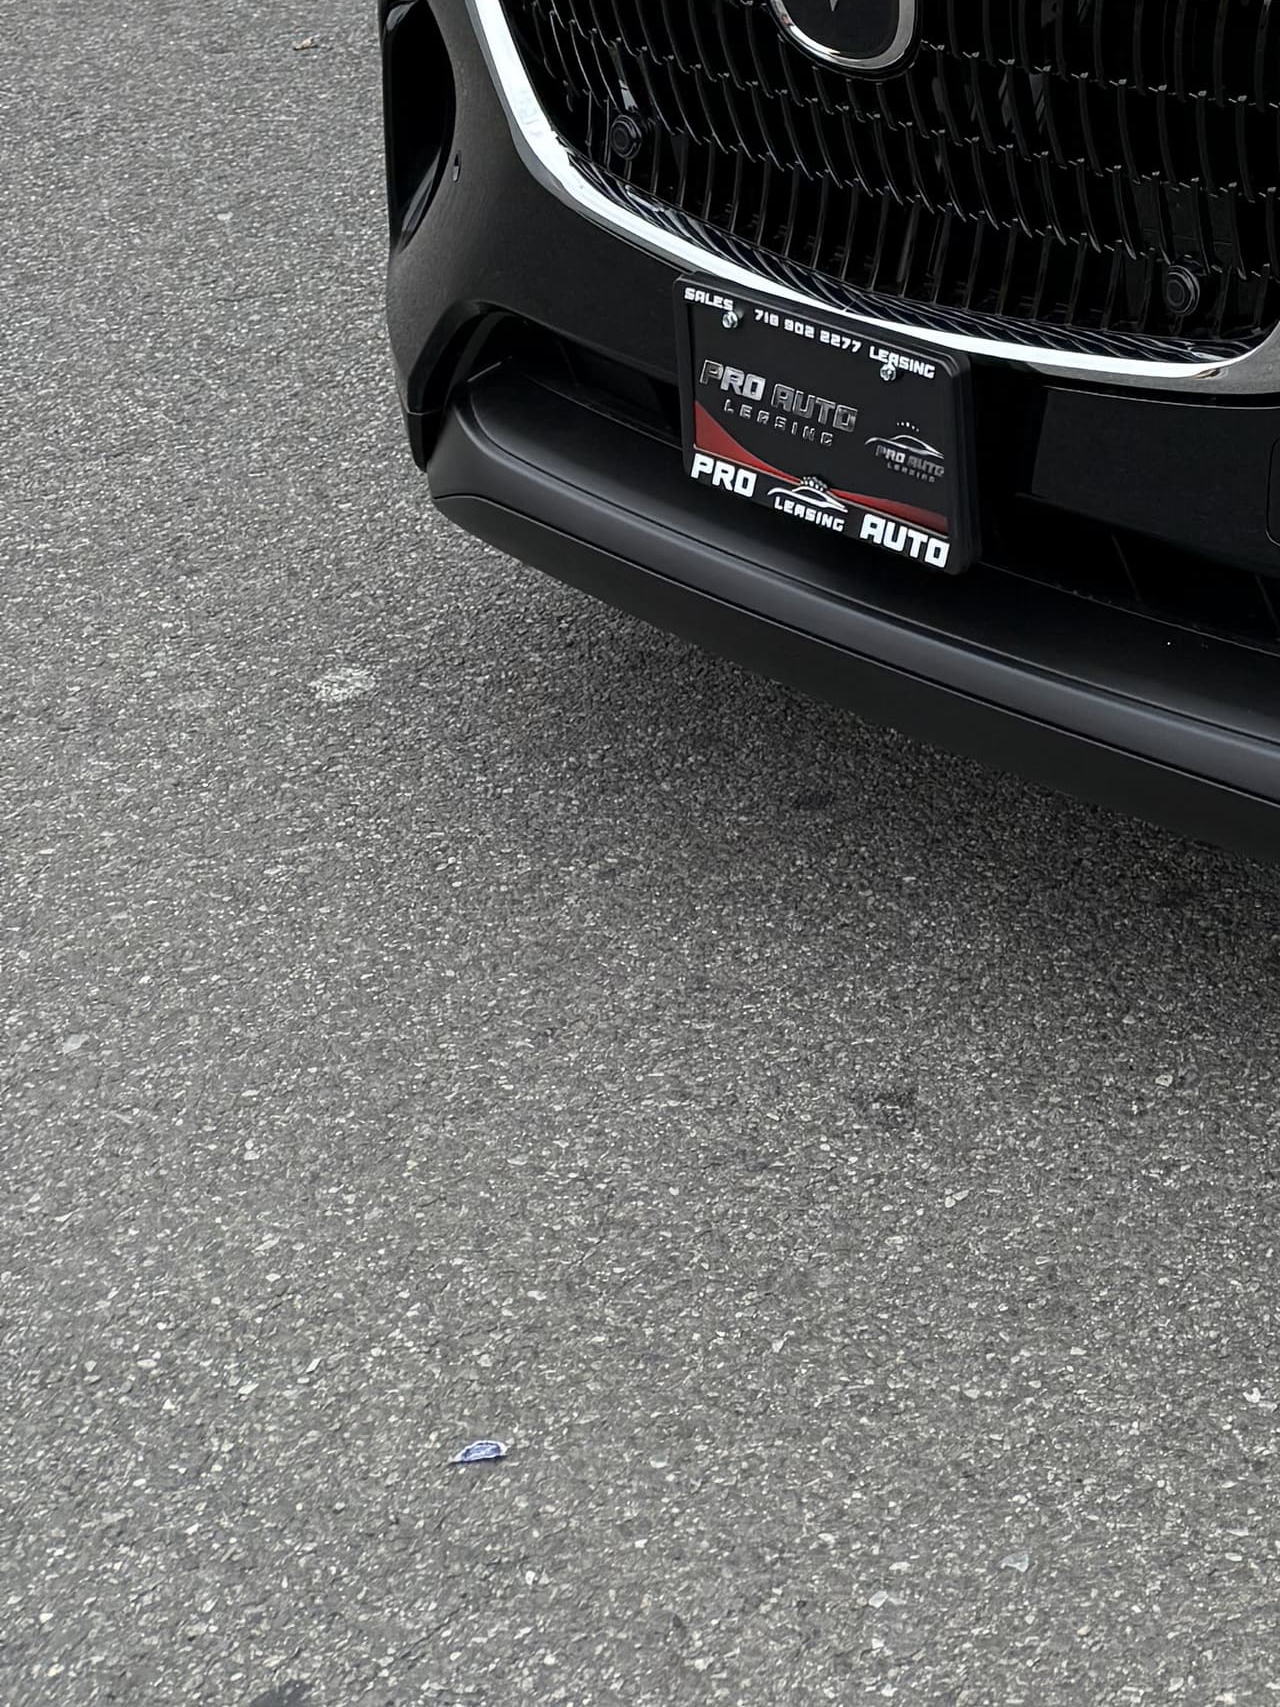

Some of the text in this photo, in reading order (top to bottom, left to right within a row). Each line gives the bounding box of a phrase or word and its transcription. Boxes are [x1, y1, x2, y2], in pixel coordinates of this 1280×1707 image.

[684, 287, 733, 311] SALES
[754, 309, 935, 379] 718 902 2277 LEASING
[700, 359, 858, 433] PRO AUTO
[724, 398, 833, 447] LEASING
[690, 452, 757, 498] PRO
[875, 445, 945, 477] PRO AUTO
[774, 496, 845, 532] LEASING
[860, 513, 950, 569] AUTO
